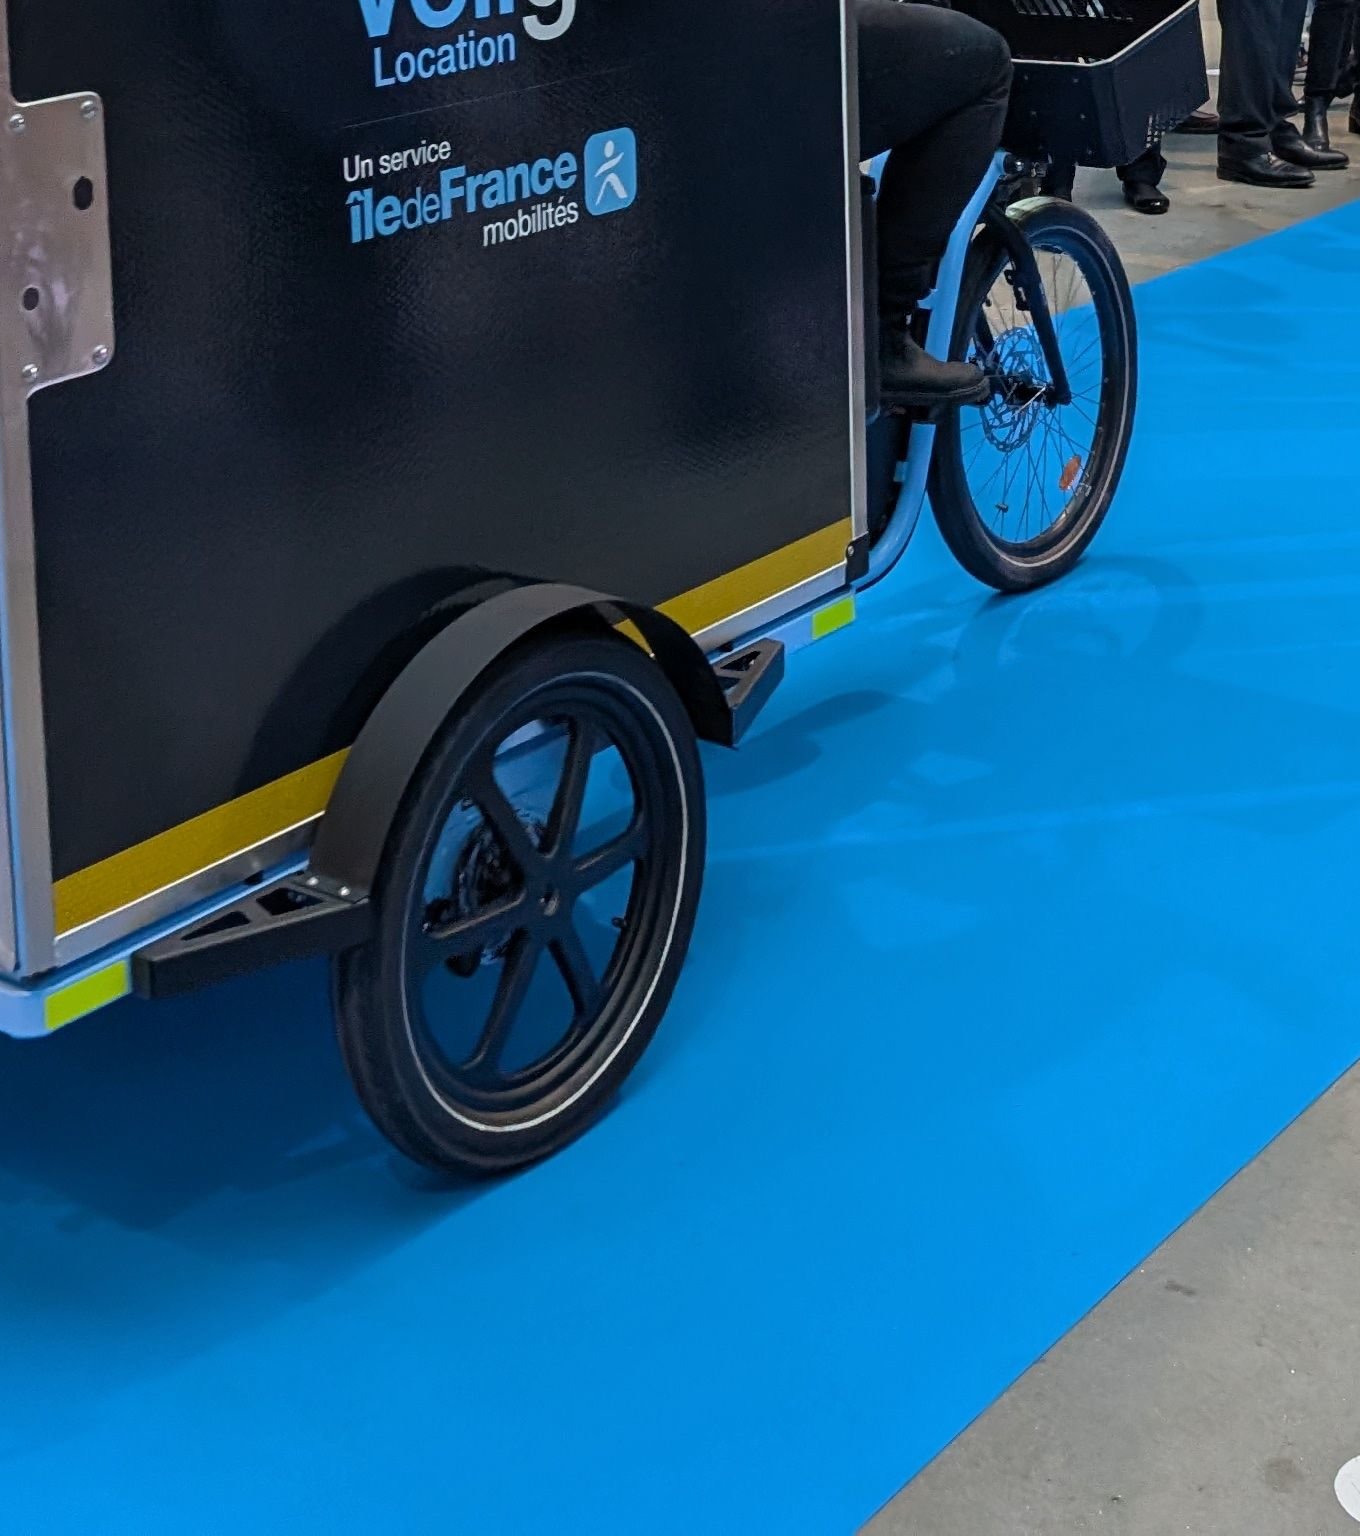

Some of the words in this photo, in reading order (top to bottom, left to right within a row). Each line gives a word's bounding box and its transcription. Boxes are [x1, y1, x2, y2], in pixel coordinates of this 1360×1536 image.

[373, 30, 517, 88] Location
[342, 155, 374, 183] Un
[378, 138, 452, 175] service
[481, 197, 579, 248] mobilités
